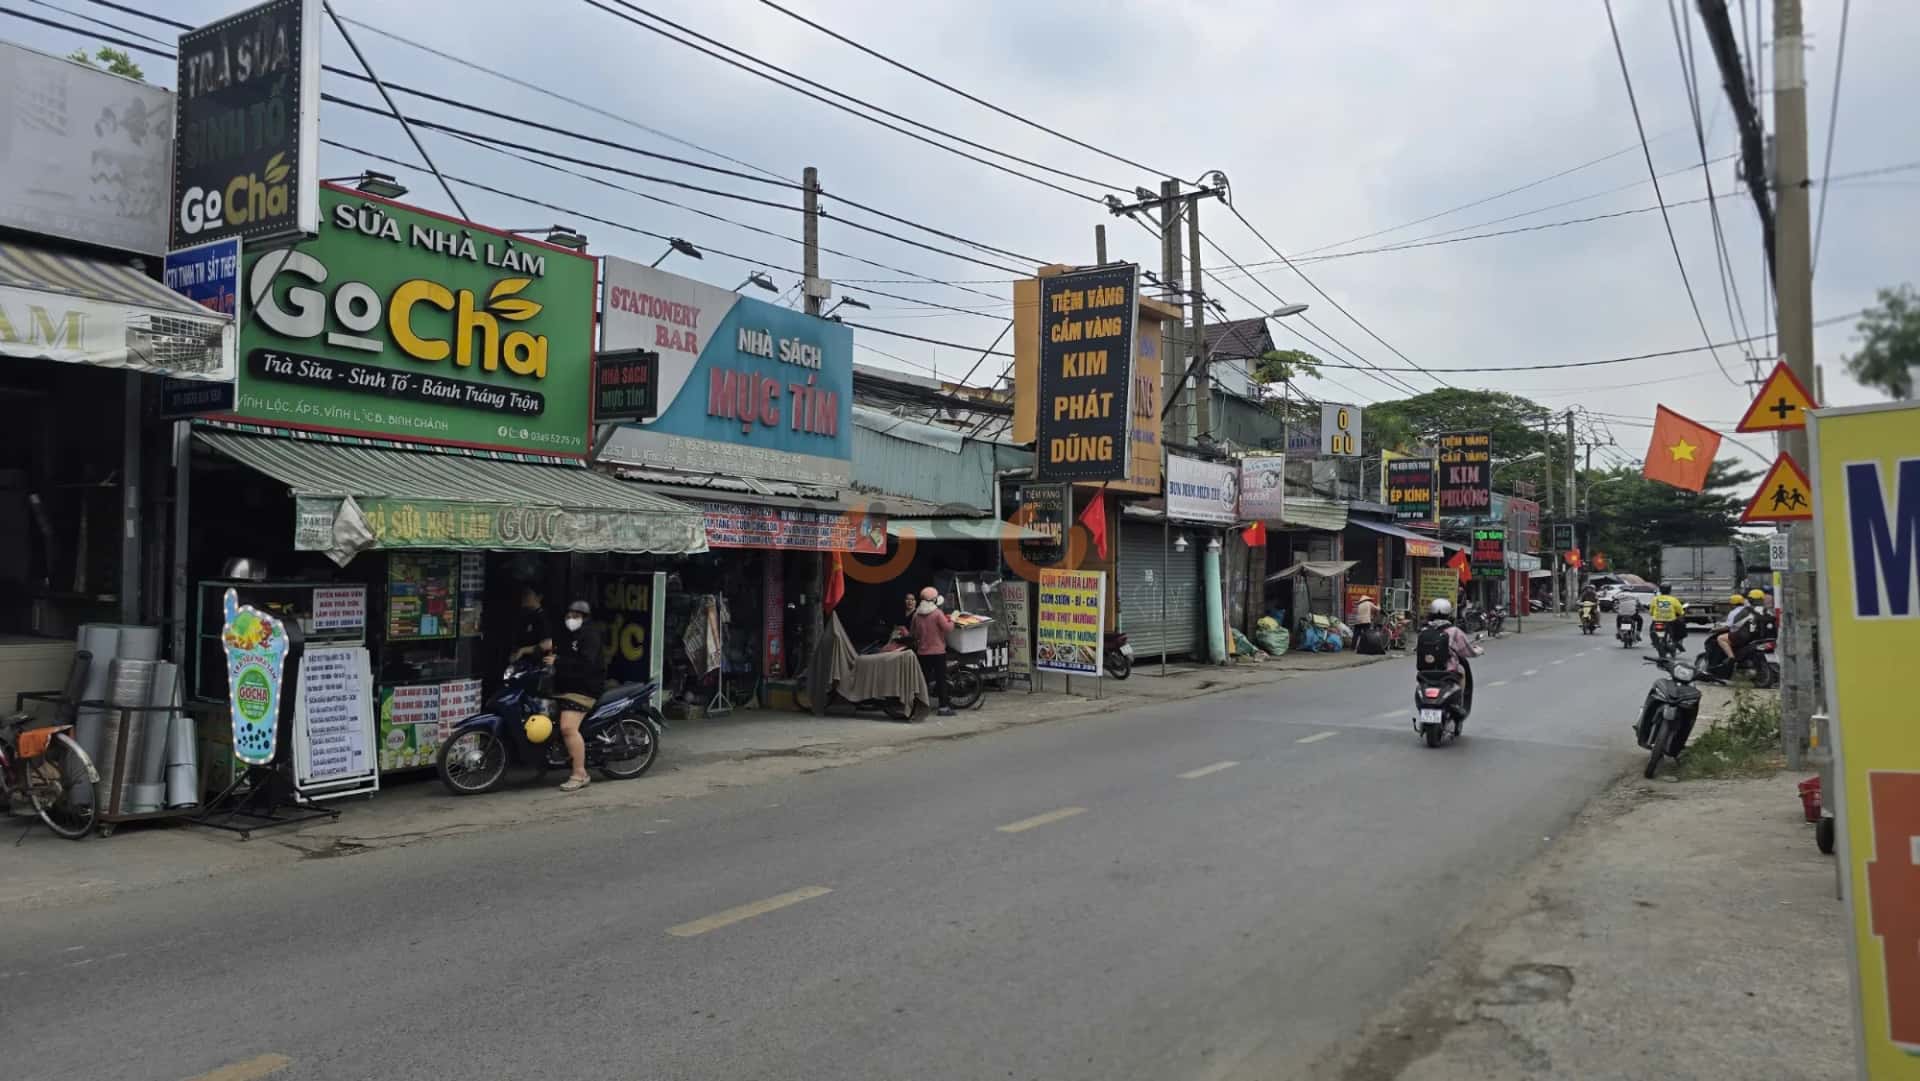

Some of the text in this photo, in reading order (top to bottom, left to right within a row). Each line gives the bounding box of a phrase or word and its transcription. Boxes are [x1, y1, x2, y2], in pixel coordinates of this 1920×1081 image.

[335, 202, 401, 243] SỮA
[411, 224, 478, 263] NHÀ
[487, 240, 545, 276] LÀM
[611, 286, 701, 328] STATIONERY
[1051, 285, 1125, 312] TIỆM VÀNG
[655, 325, 698, 354] BAR
[1085, 316, 1121, 338] VÀNG
[738, 328, 822, 370] NHÀ SÁCH
[1062, 350, 1108, 378] KIM
[264, 353, 293, 376] Trà
[297, 360, 333, 381] Sữa
[348, 367, 386, 390] Sinh
[390, 370, 409, 392] Tố
[422, 379, 461, 400] Bánh
[464, 384, 505, 409] Tráng
[509, 392, 539, 412] Trộn
[708, 367, 838, 438] MỰC TÍM
[1054, 388, 1114, 421] PHÁT
[1050, 433, 1113, 463] DŨNG
[1449, 466, 1479, 483] KIM
[1404, 486, 1430, 502] KÍNH
